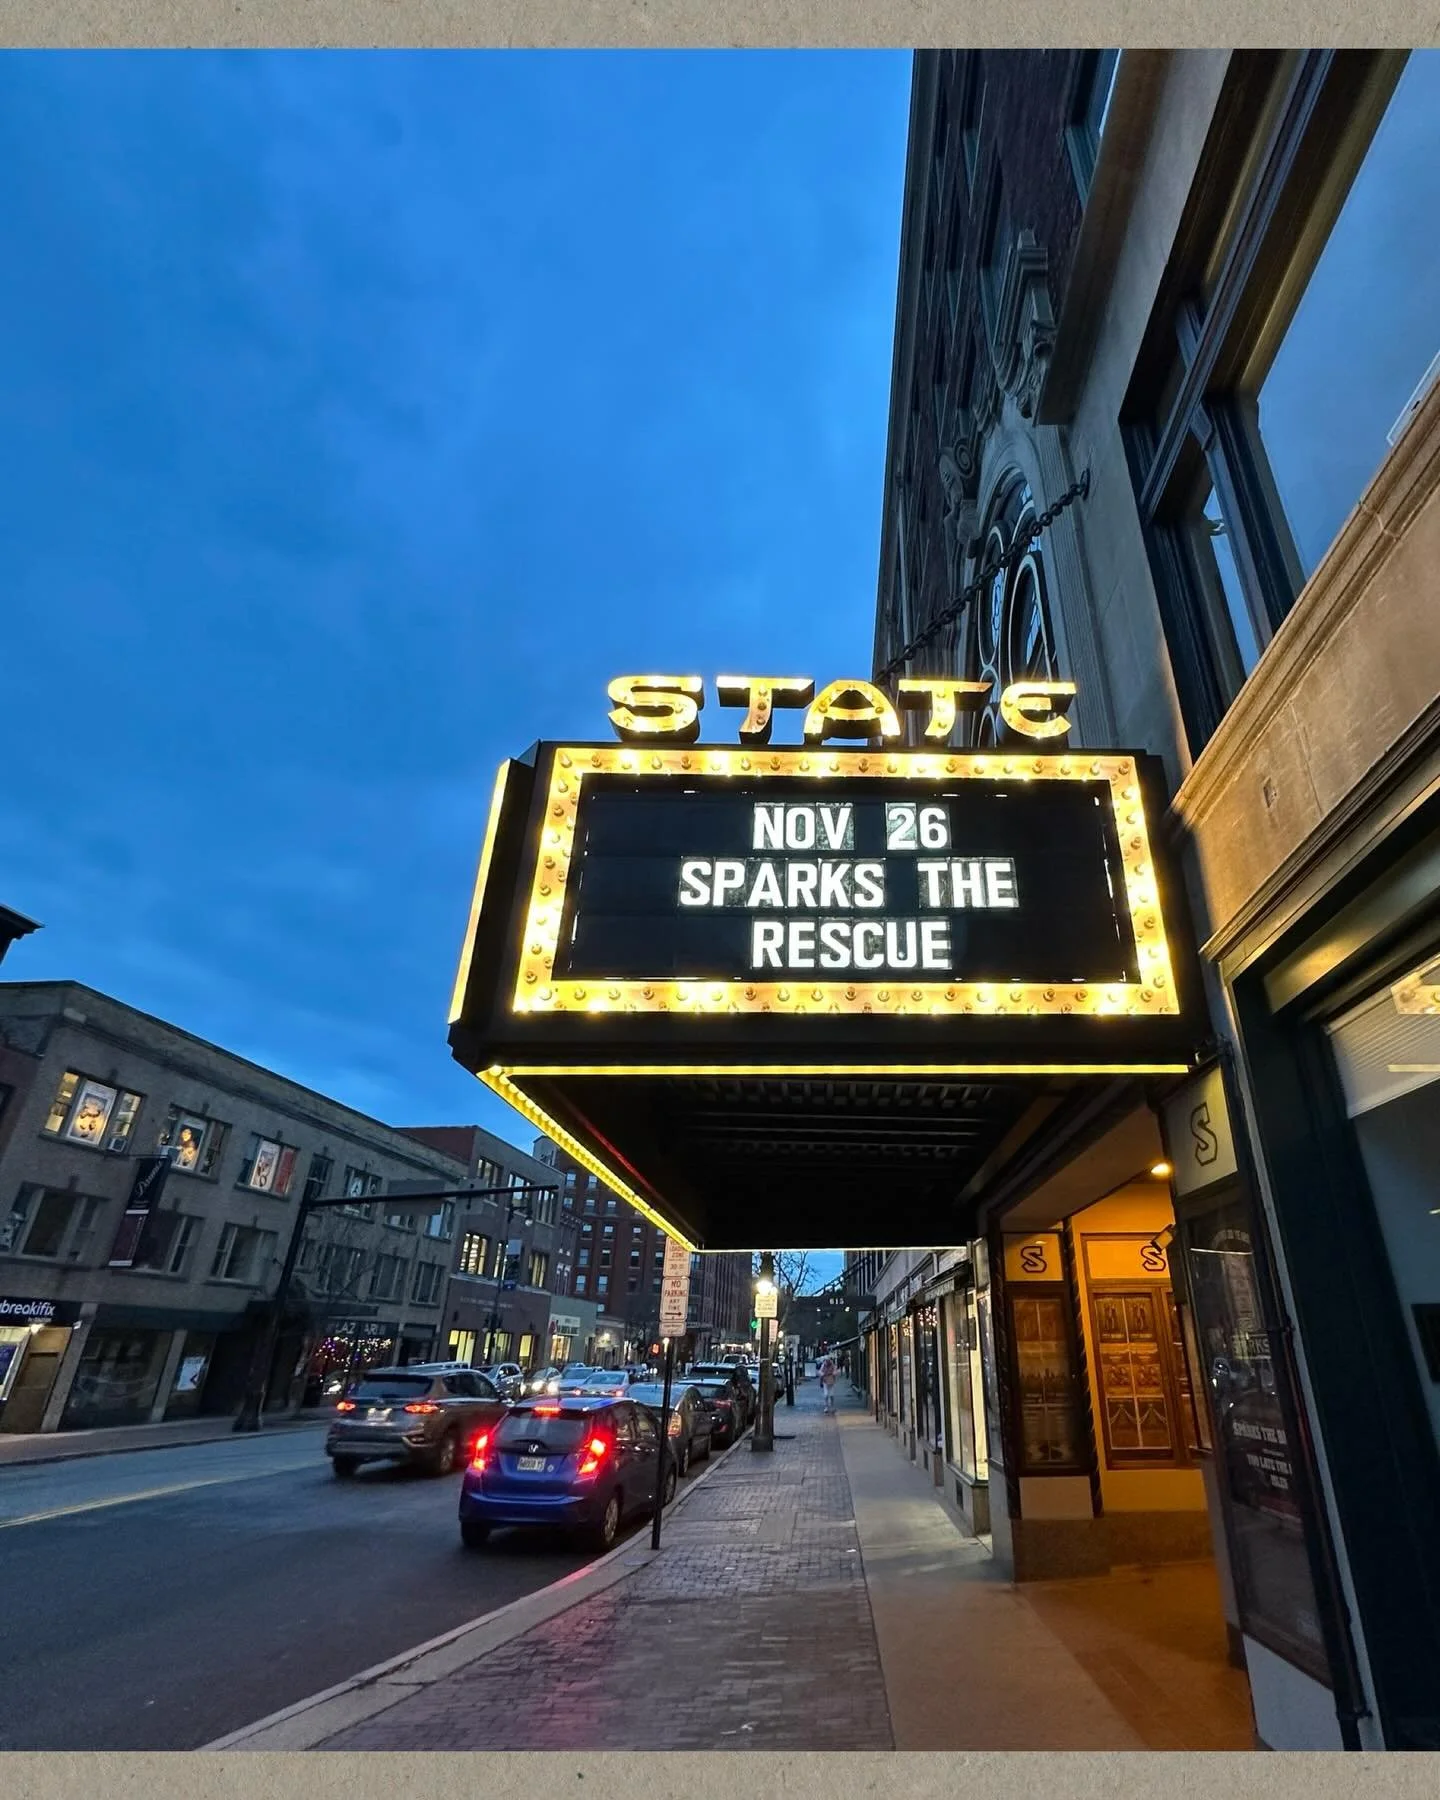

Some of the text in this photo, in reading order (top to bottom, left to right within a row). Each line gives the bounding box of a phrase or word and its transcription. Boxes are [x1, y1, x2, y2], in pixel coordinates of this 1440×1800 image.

[608, 675, 1077, 740] STATE
[752, 806, 949, 850] NOV 26
[679, 860, 1016, 908] SPARKS THE
[752, 920, 951, 969] RESCUE
[1190, 1102, 1219, 1167] S
[1020, 1245, 1048, 1273] S
[1140, 1245, 1167, 1273] S
[664, 1289, 687, 1297] PARKING
[671, 1280, 682, 1288] NO
[0, 1299, 56, 1316] breakifix
